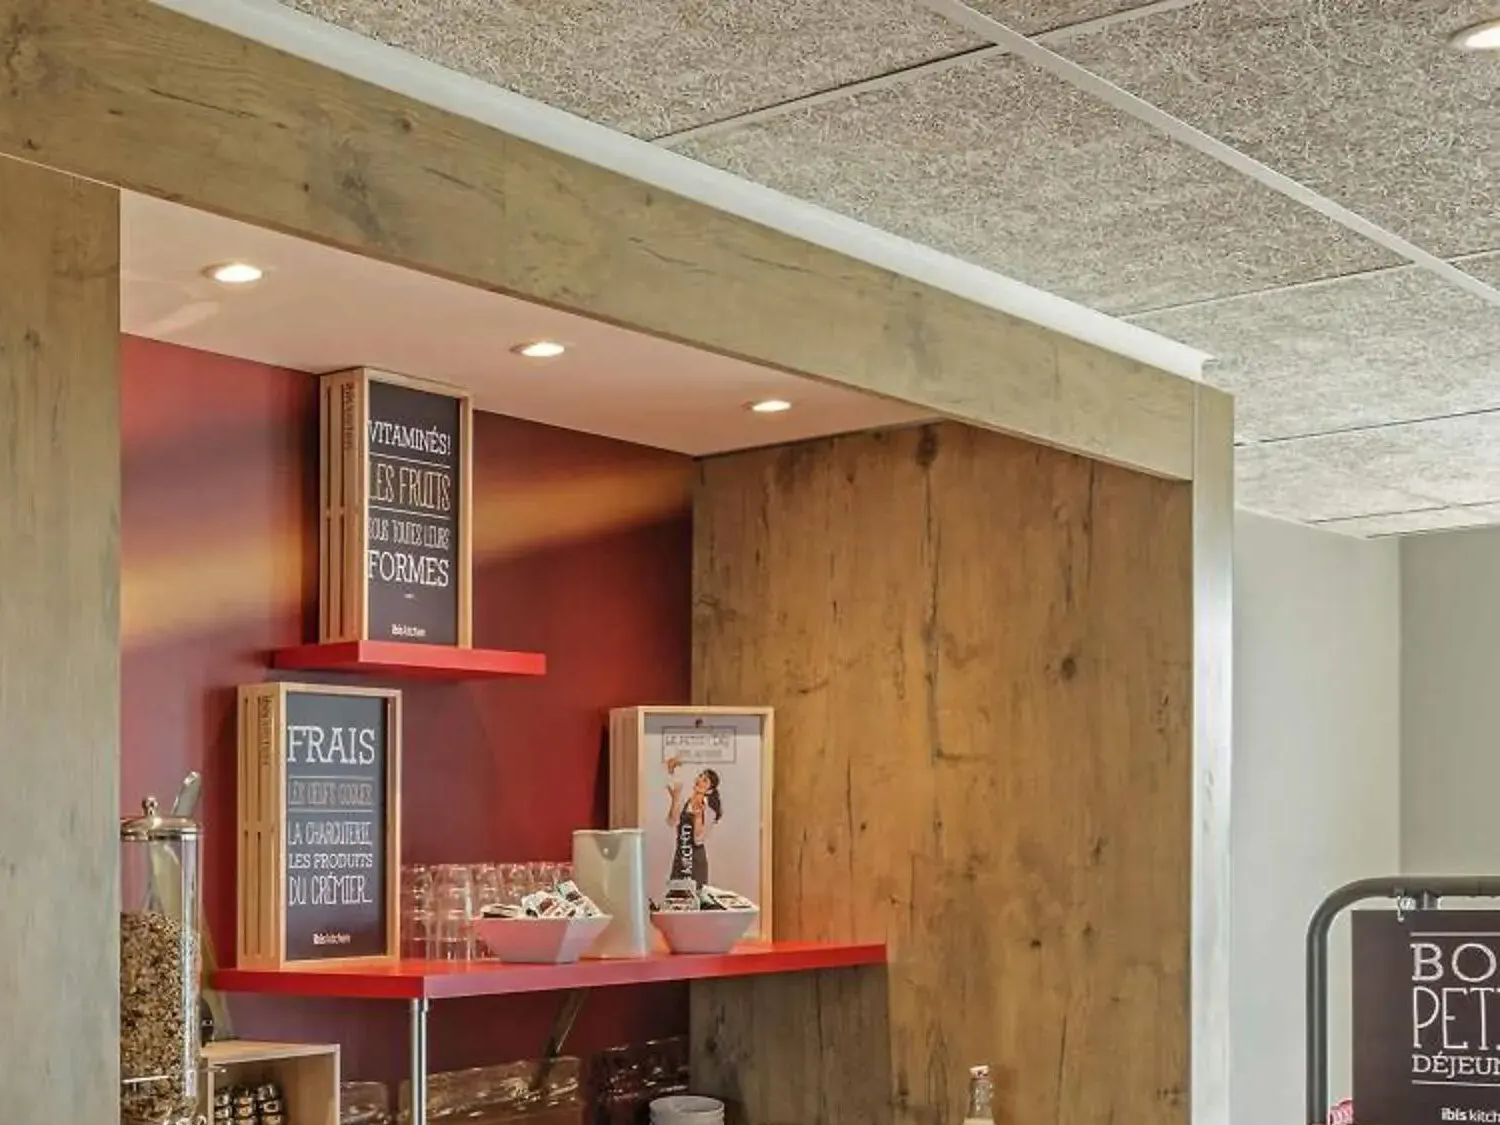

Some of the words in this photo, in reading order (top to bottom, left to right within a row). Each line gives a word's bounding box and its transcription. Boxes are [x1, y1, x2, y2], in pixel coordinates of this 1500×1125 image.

[367, 419, 451, 456] VITAMINÉS!
[399, 466, 451, 512] FRUITS
[367, 549, 449, 588] FORMES
[287, 725, 376, 765] FRAIS
[288, 821, 303, 845] LA
[289, 853, 311, 869] LES
[313, 853, 373, 869] PRODUITS
[289, 874, 307, 906] DU
[1412, 986, 1500, 1051] PET
[1412, 1050, 1500, 1079] DÉJEU
[1441, 1108, 1468, 1121] ibis
